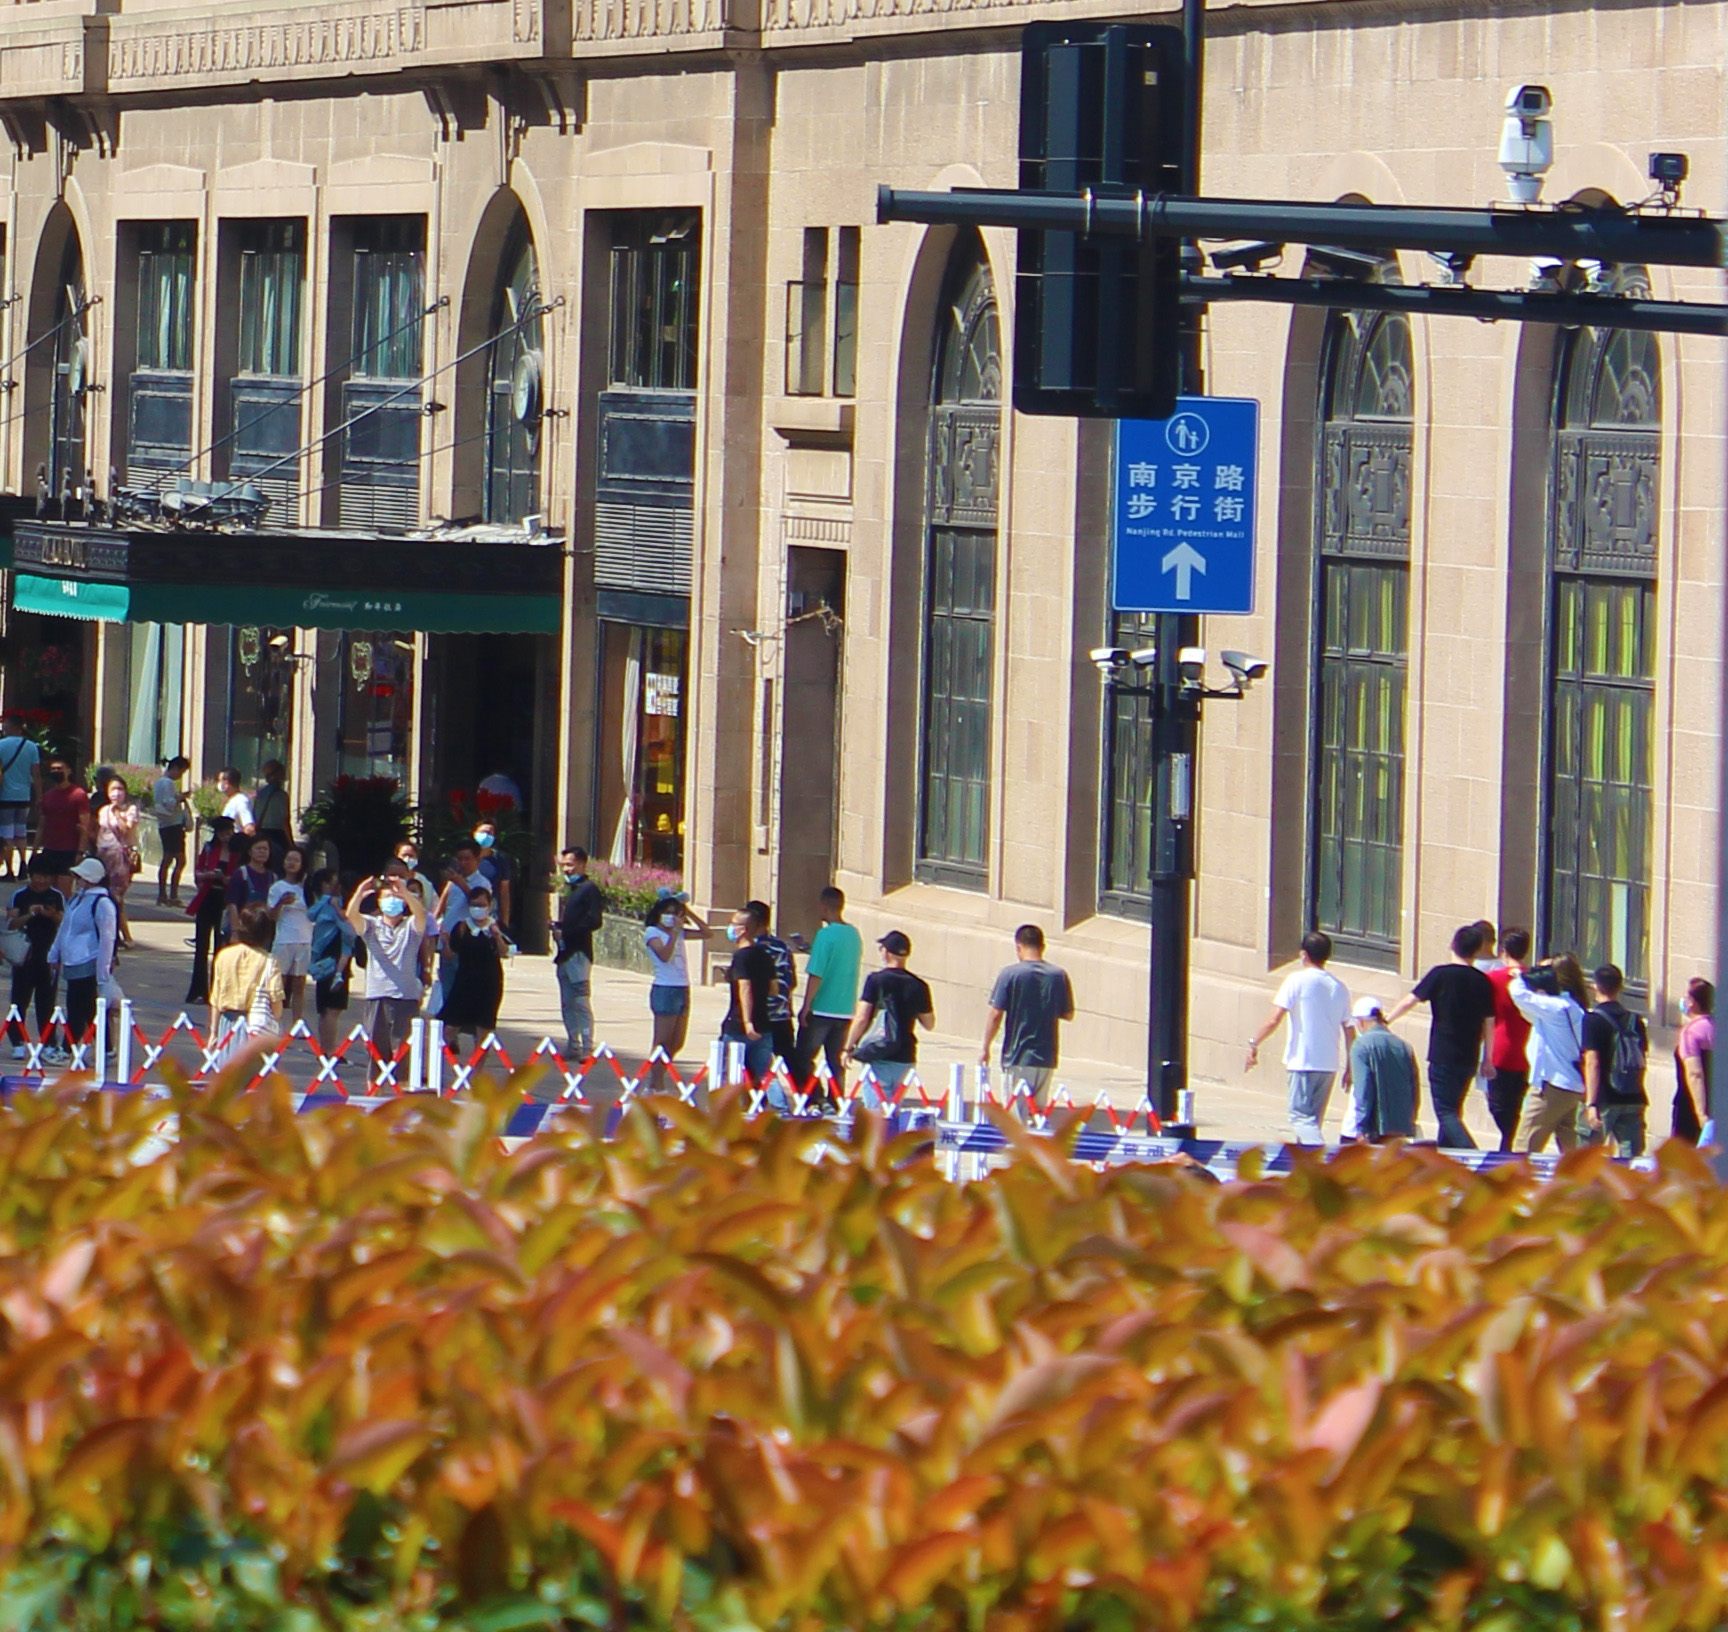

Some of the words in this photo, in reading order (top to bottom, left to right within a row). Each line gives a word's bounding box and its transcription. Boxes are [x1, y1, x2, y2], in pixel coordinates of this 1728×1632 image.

[1127, 461, 1245, 491] 南京路
[1127, 493, 1245, 523] 步行街
[1126, 527, 1161, 538] Nanjing
[1177, 528, 1224, 539] Pedestrian
[1226, 530, 1245, 539] Mall
